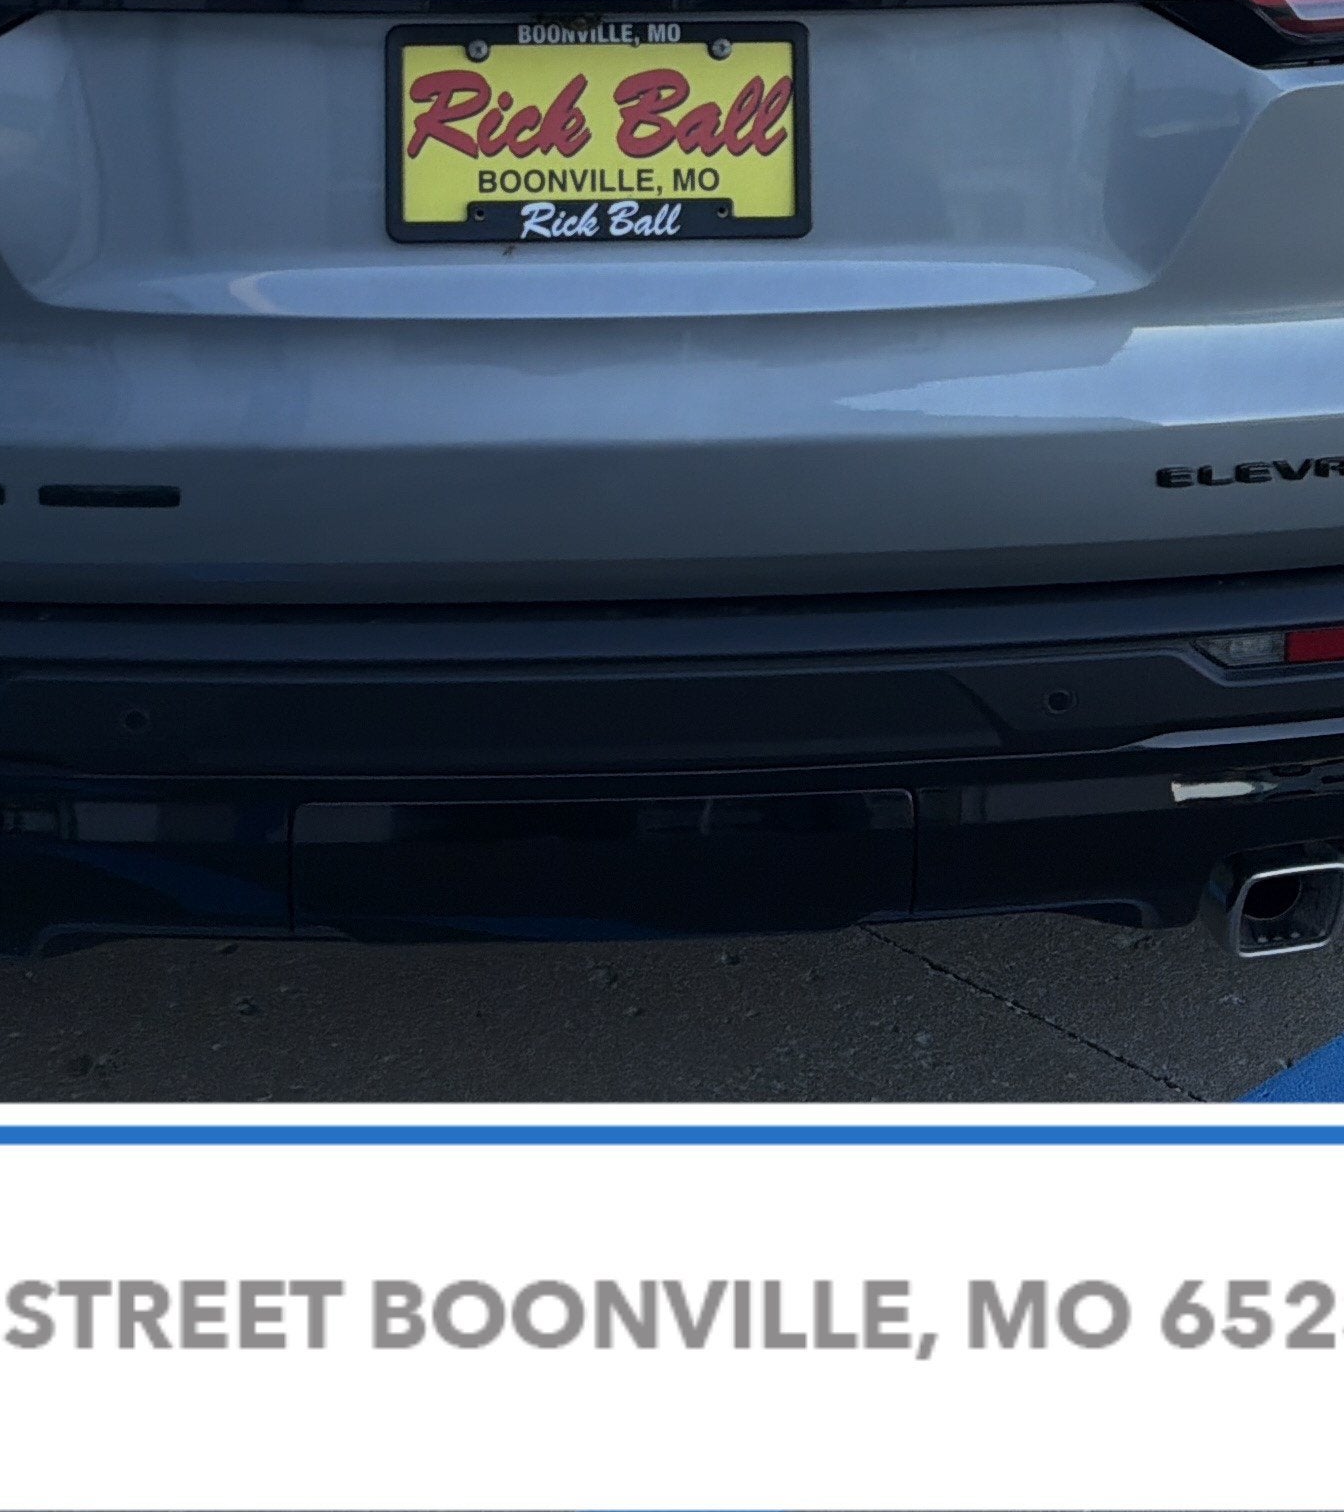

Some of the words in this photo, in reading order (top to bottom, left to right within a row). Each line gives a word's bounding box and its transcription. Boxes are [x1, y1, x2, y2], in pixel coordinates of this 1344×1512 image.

[517, 24, 641, 47] BOONVILLE,
[647, 22, 682, 44] MO
[407, 68, 593, 160] Rick
[612, 67, 794, 160] Ball
[477, 167, 665, 197] BOONVILLE,
[672, 166, 721, 193] MO
[520, 200, 601, 240] Rick
[608, 199, 682, 239] Ball
